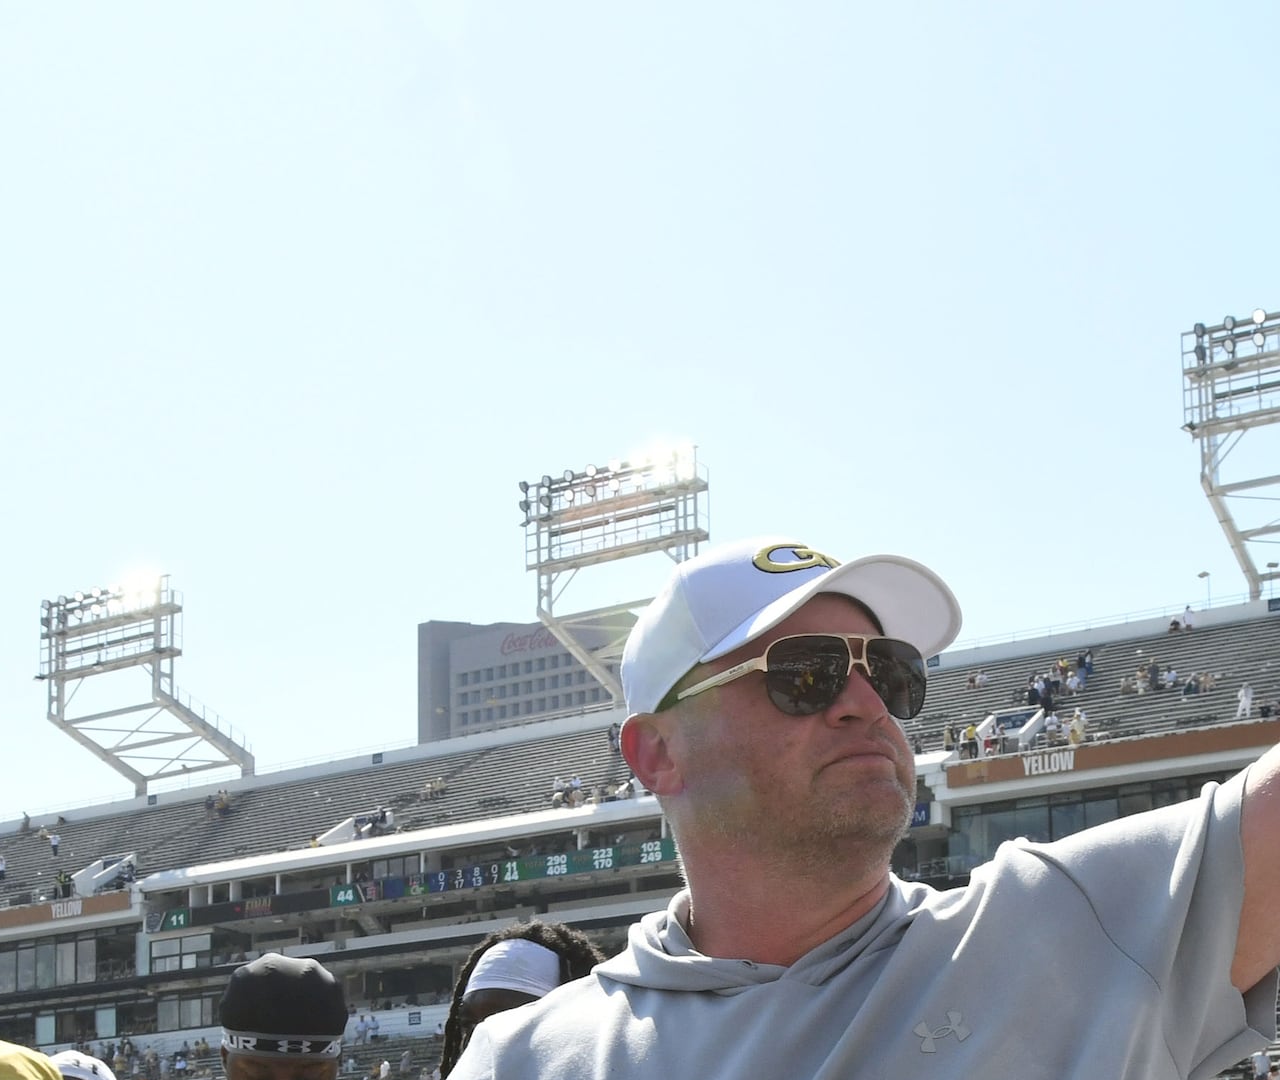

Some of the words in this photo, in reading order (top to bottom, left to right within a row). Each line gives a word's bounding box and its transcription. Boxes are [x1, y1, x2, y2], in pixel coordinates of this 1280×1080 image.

[1023, 751, 1075, 776] YELLOW
[546, 854, 567, 866] 290
[593, 848, 613, 859] 223
[641, 841, 661, 852] 102
[546, 865, 568, 876] 405
[593, 858, 613, 869] 170
[640, 851, 662, 863] 249
[337, 889, 353, 902] 44
[51, 900, 82, 919] YELLOW
[170, 913, 185, 926] 11
